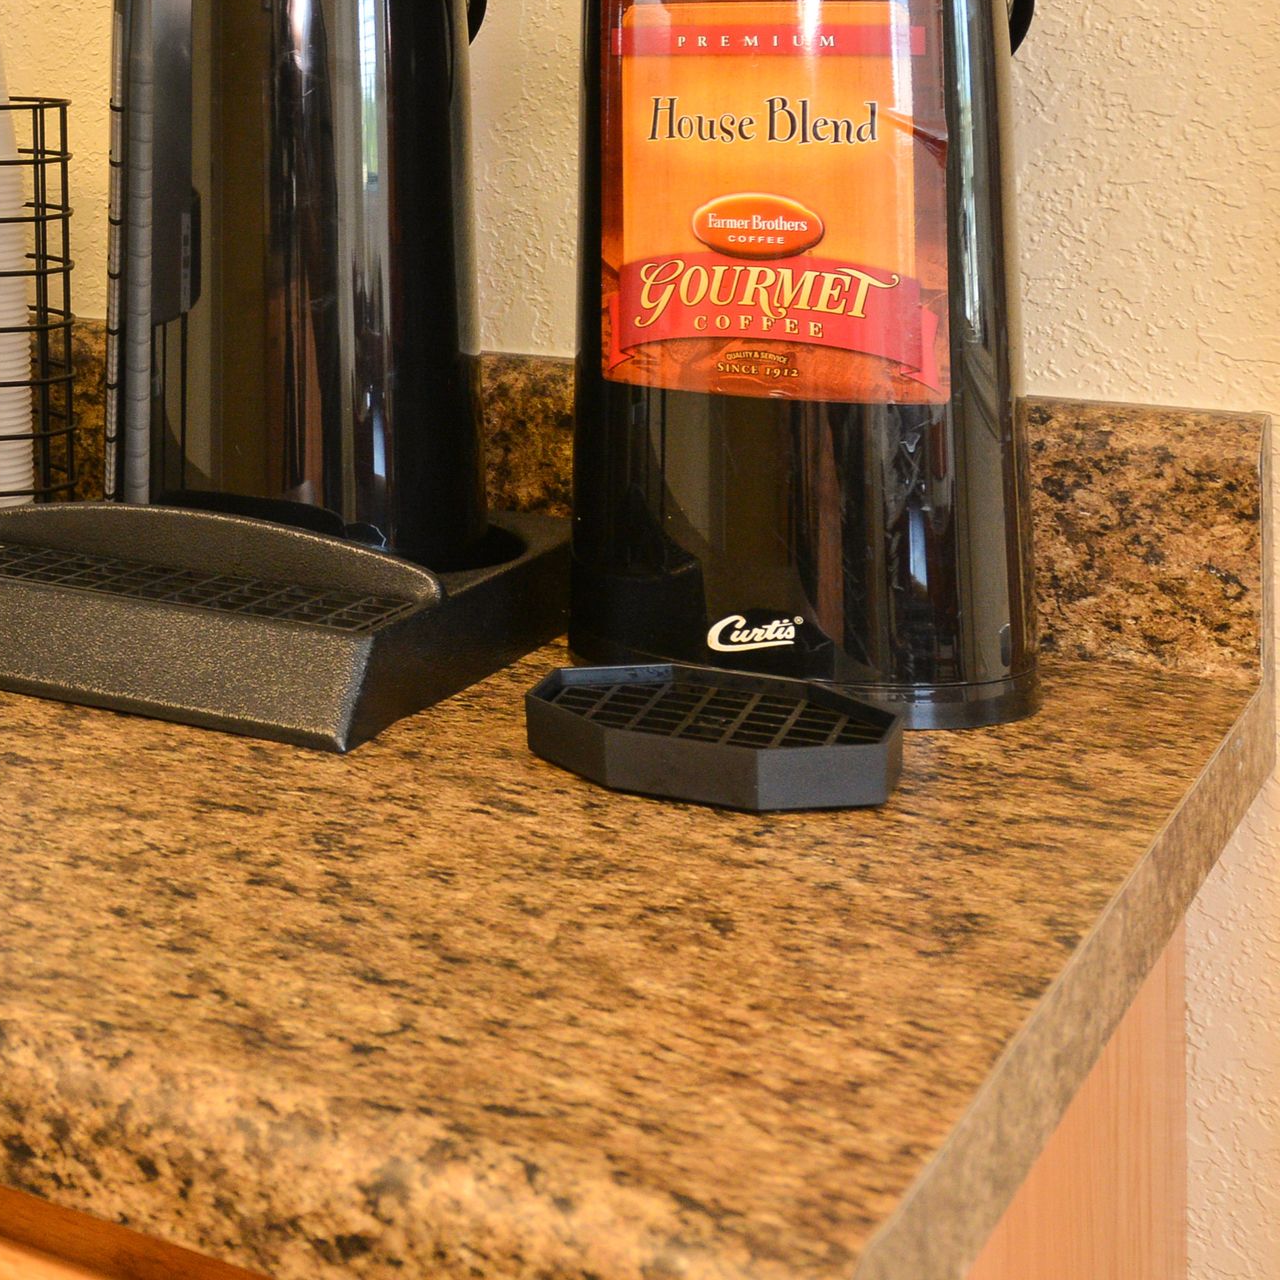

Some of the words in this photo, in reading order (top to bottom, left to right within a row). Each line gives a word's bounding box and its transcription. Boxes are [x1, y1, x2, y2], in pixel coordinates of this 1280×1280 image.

[678, 33, 836, 48] PREMIUM
[647, 96, 756, 142] House
[765, 95, 880, 144] Blend
[707, 213, 750, 229] Farmer
[751, 214, 808, 231] Brothers
[727, 235, 785, 244] COFFEE
[634, 259, 900, 328] GOURMET
[693, 314, 825, 338] COFFEE
[726, 350, 753, 360] QUALITY
[717, 361, 759, 374] SINCE
[765, 367, 799, 378] 1912
[707, 614, 796, 652] Curtis
